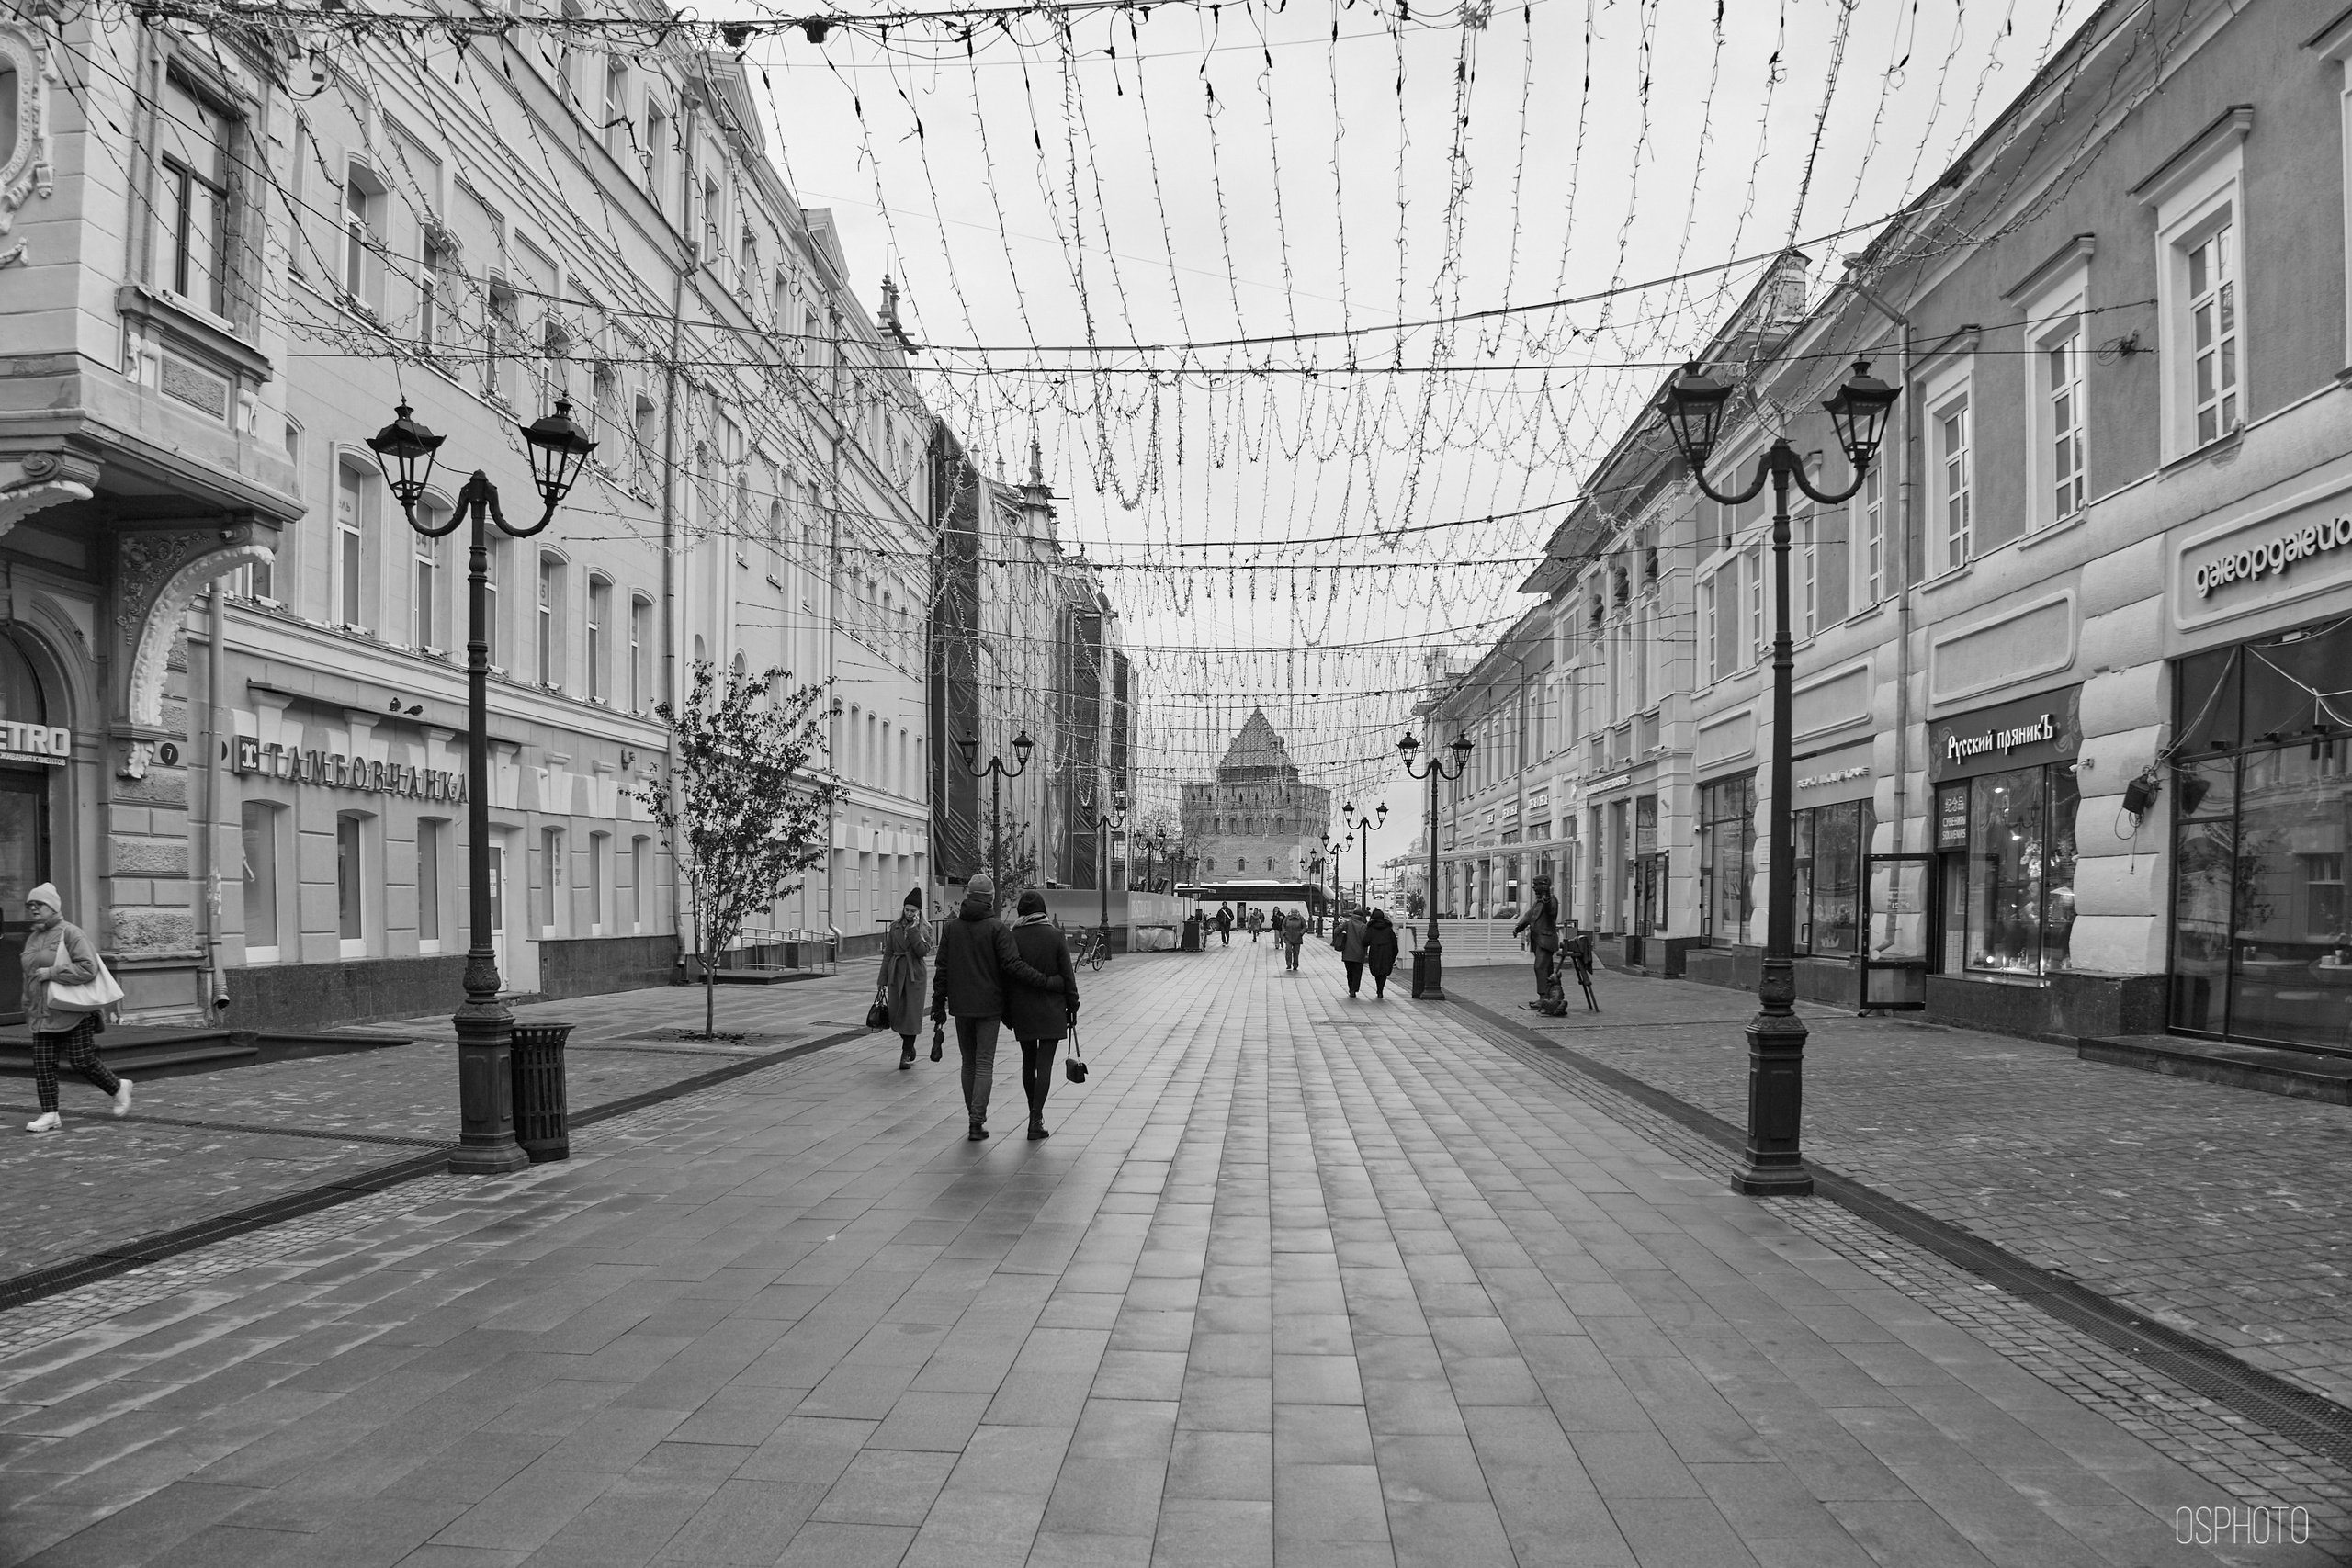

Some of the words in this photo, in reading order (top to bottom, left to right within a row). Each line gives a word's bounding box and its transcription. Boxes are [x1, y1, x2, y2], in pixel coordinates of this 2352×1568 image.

[1947, 729, 1993, 764] Русский
[1996, 714, 2053, 755] пряникЪ
[263, 742, 470, 804] ТАМБОВЧАНКА
